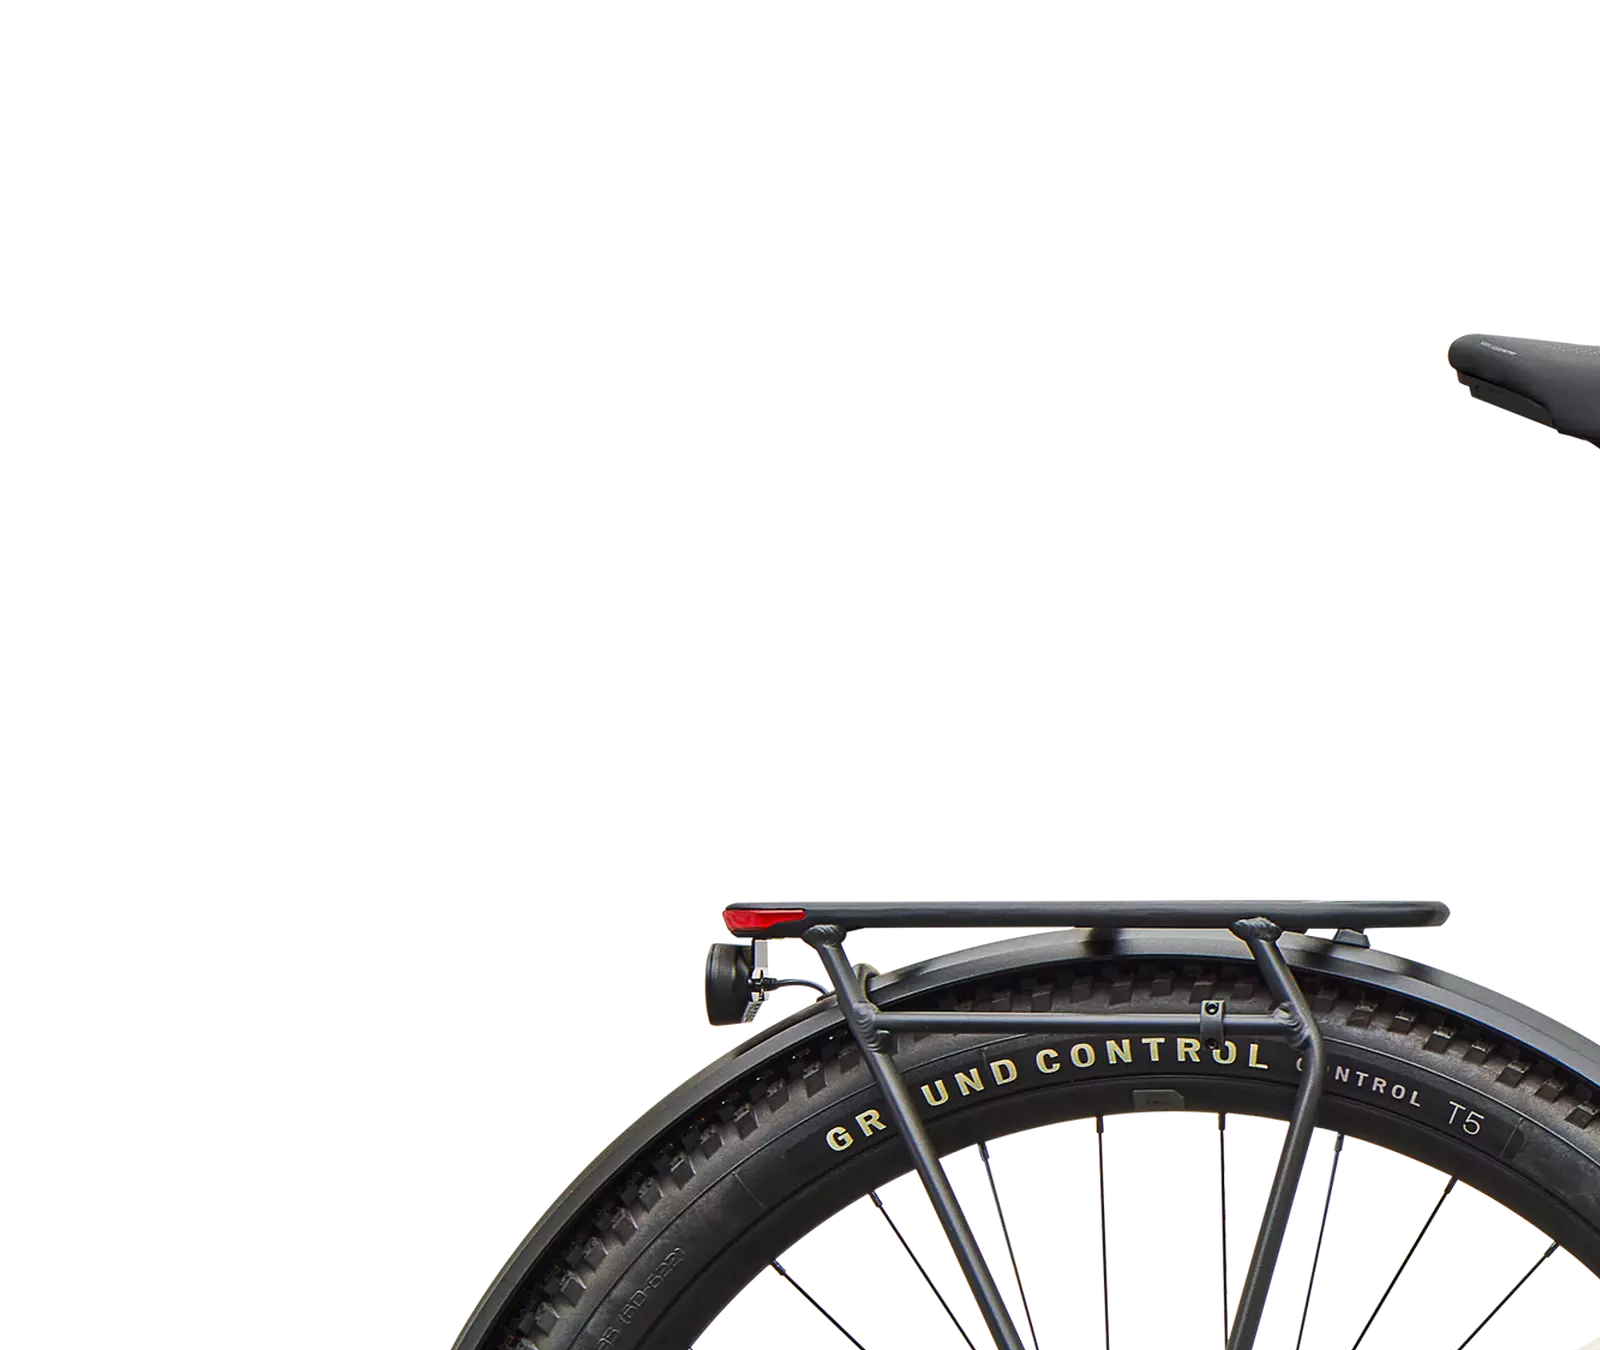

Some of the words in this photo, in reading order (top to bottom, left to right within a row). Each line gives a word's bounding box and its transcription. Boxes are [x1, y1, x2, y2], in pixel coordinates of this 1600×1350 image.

[825, 1058, 1018, 1152] GRUND
[1035, 1035, 1270, 1075] CONTROL
[1295, 1056, 1421, 1108] CNTROL
[1448, 1100, 1485, 1136] T5
